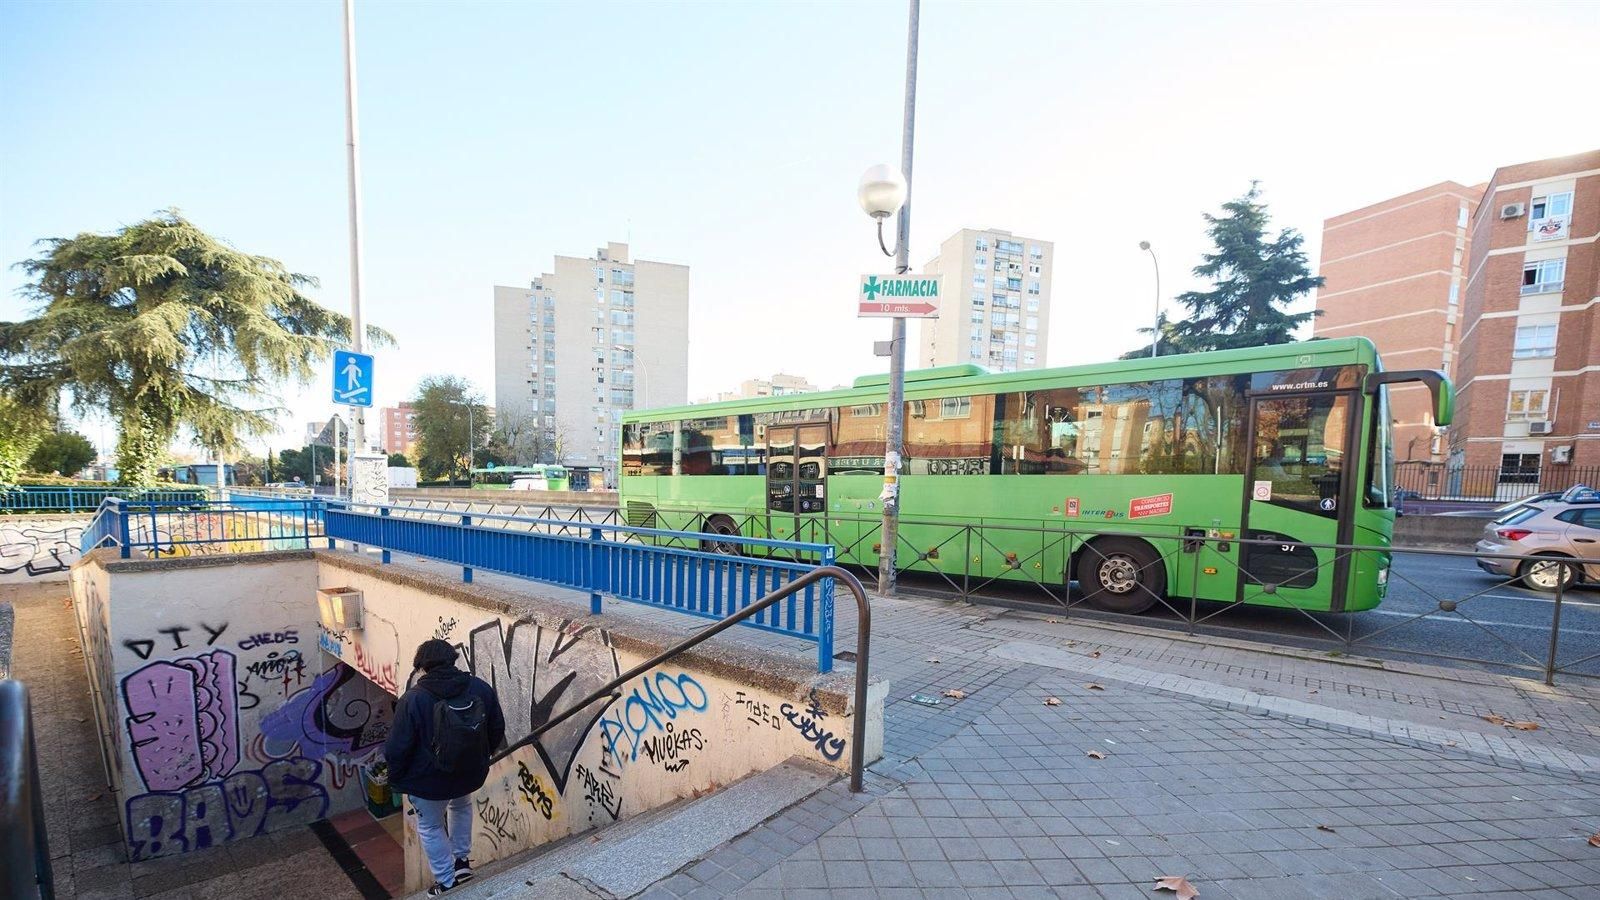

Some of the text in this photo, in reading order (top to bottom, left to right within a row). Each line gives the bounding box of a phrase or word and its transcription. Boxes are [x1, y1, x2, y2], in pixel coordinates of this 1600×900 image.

[881, 279, 938, 297] FARMACIA
[880, 304, 890, 312] 10
[1272, 381, 1329, 391] www.crtm.es
[1134, 501, 1169, 512] TRANSPORTES
